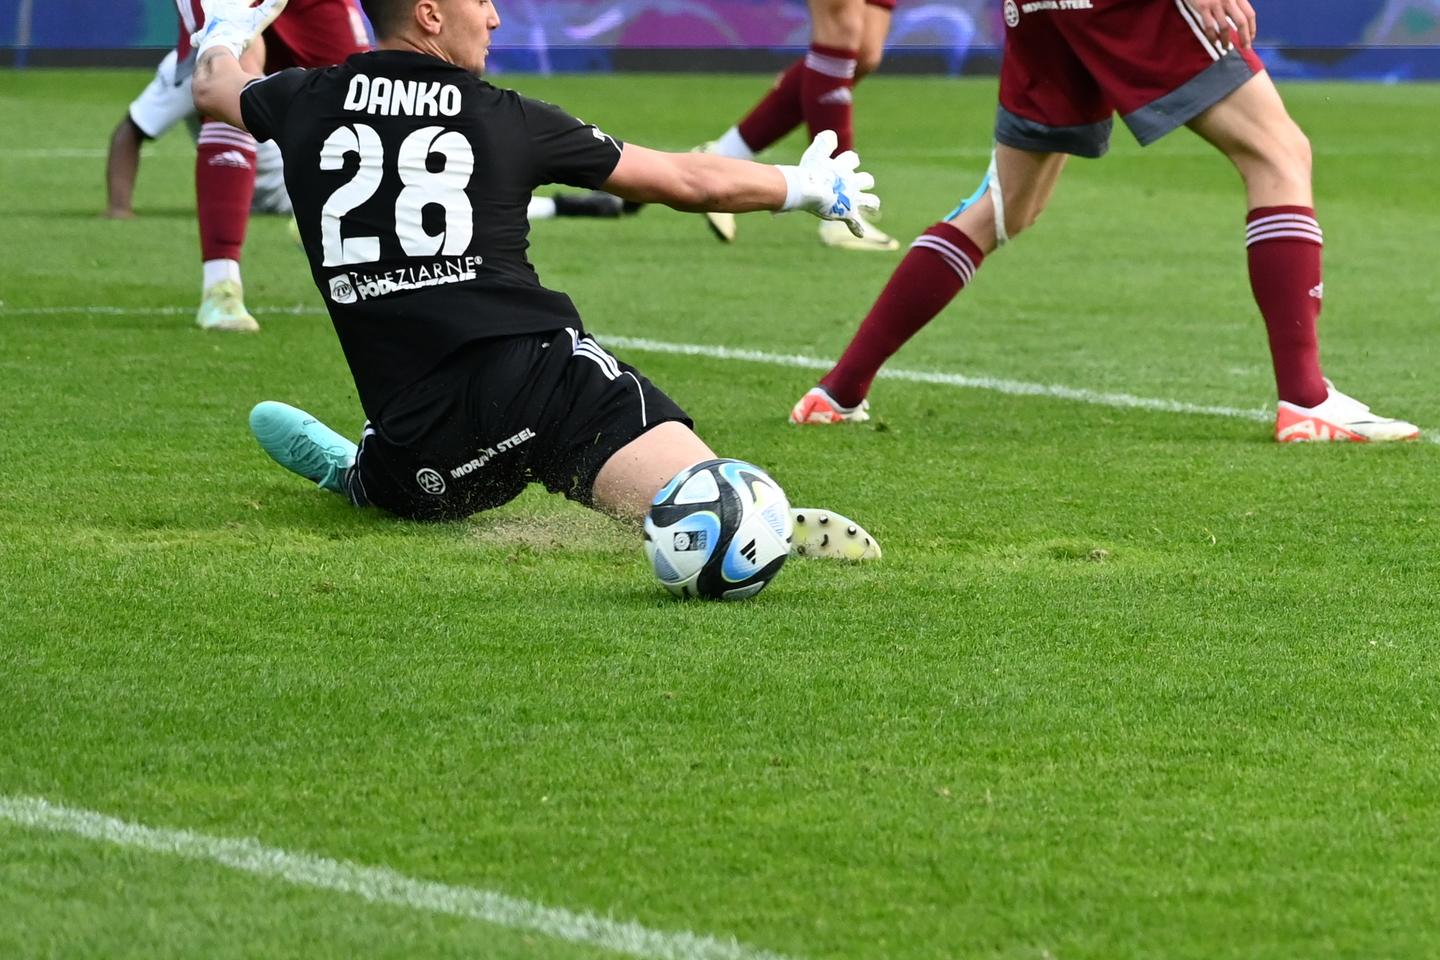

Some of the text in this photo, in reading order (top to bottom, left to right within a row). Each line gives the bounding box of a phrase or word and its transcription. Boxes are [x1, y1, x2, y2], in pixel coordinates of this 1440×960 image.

[343, 73, 462, 117] DANKO
[319, 123, 474, 267] 28
[496, 427, 536, 453] STEEL
